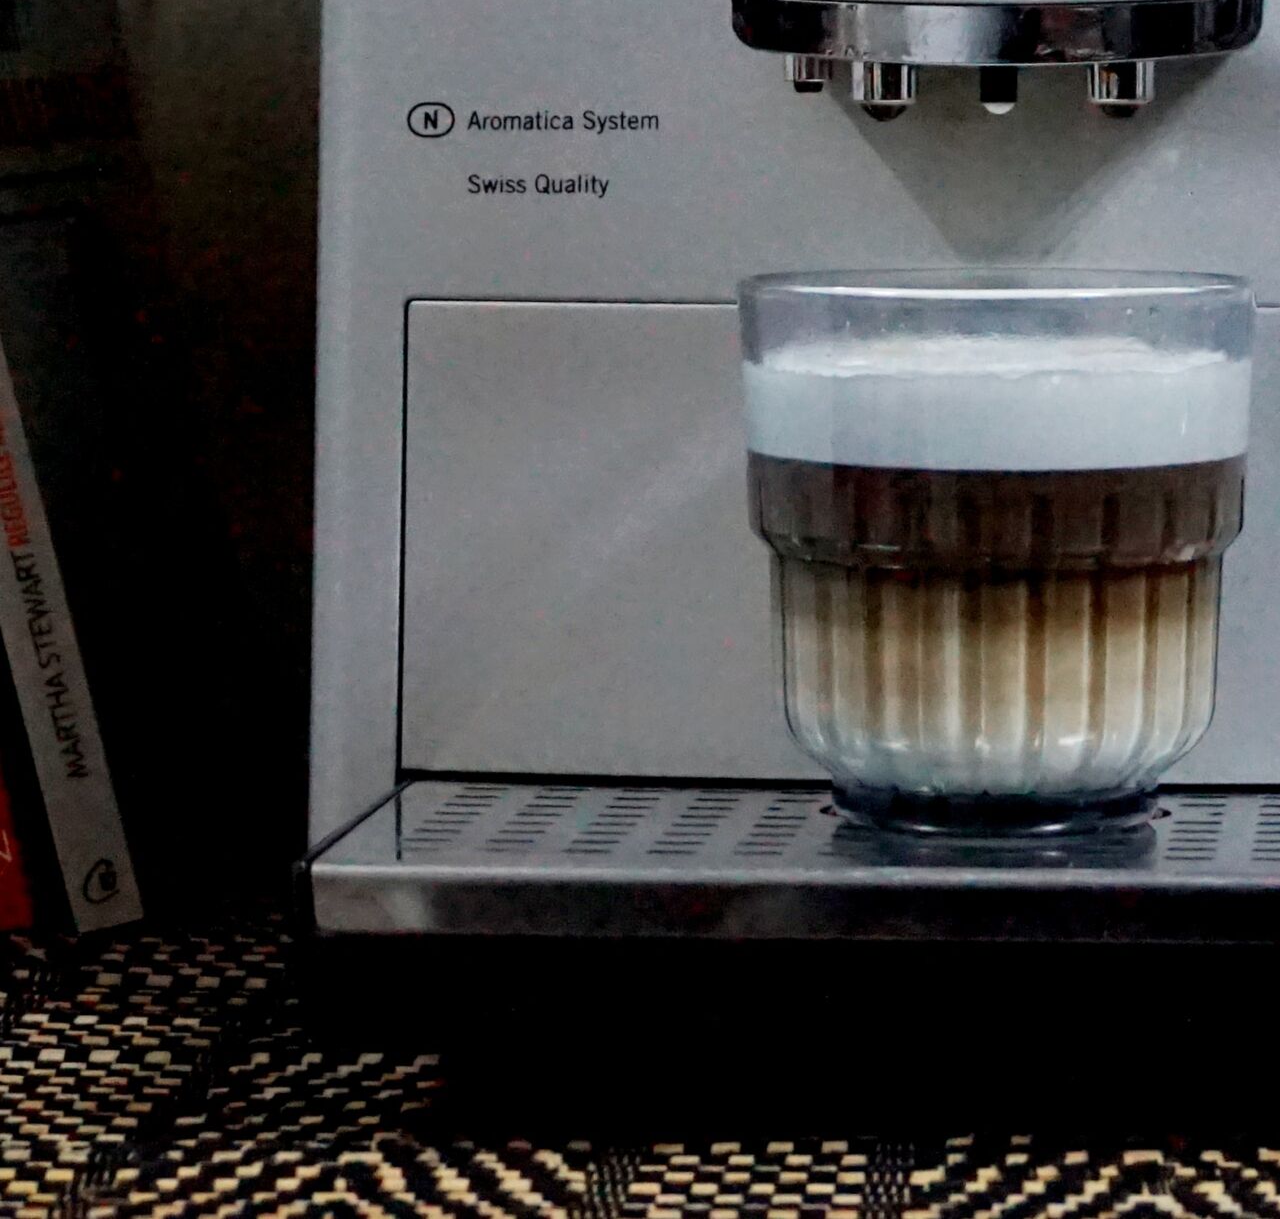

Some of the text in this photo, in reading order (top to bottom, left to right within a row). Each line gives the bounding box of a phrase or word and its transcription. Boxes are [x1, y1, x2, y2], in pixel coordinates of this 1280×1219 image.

[467, 110, 660, 135] Aromatica System
[467, 173, 609, 199] Swiss Quality
[10, 550, 63, 669] STEWART
[44, 670, 90, 780] MARTHA
